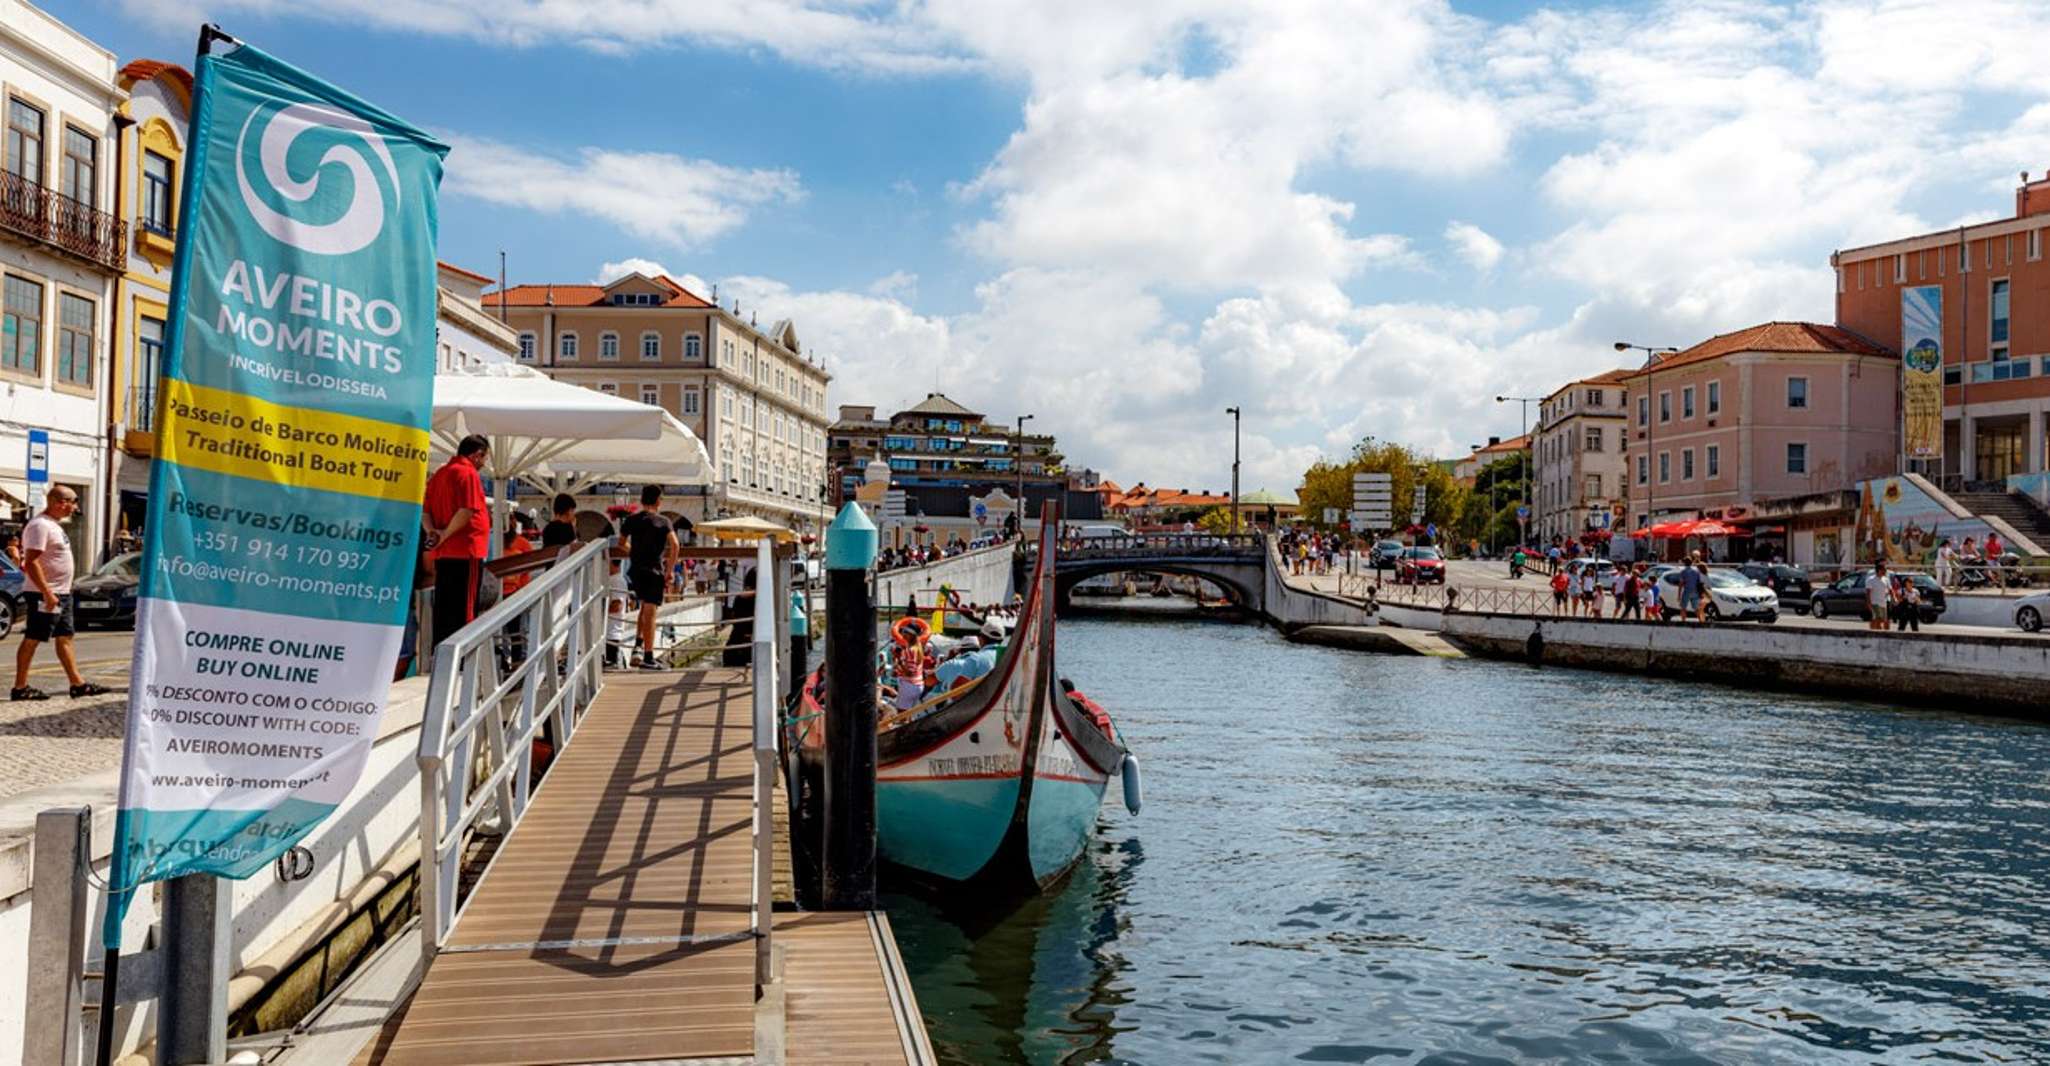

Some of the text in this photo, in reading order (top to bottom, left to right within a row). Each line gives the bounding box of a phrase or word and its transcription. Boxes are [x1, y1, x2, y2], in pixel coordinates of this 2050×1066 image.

[221, 259, 402, 337] AVEIRO
[216, 304, 402, 374] MOMENTS
[186, 430, 402, 484] Traditional Boat Tour
[250, 416, 274, 437] de
[277, 422, 339, 446] Barco
[343, 433, 428, 463] Moliceiro
[169, 492, 405, 550] Reservas/Bookings
[194, 530, 371, 570] +351 914 170 937
[157, 551, 401, 604] info@aveiro-moments.pt
[185, 630, 345, 661] COMPRE ONLINE
[197, 657, 319, 684] BUY ONLINE
[143, 708, 361, 736] 0% DISCOUNT WITH CODE:
[162, 686, 249, 706] DESCONTO
[252, 694, 290, 709] COM
[294, 697, 307, 710] O
[311, 696, 379, 715] CÓDIGO:
[166, 738, 324, 760] AVEIROMOMENTS
